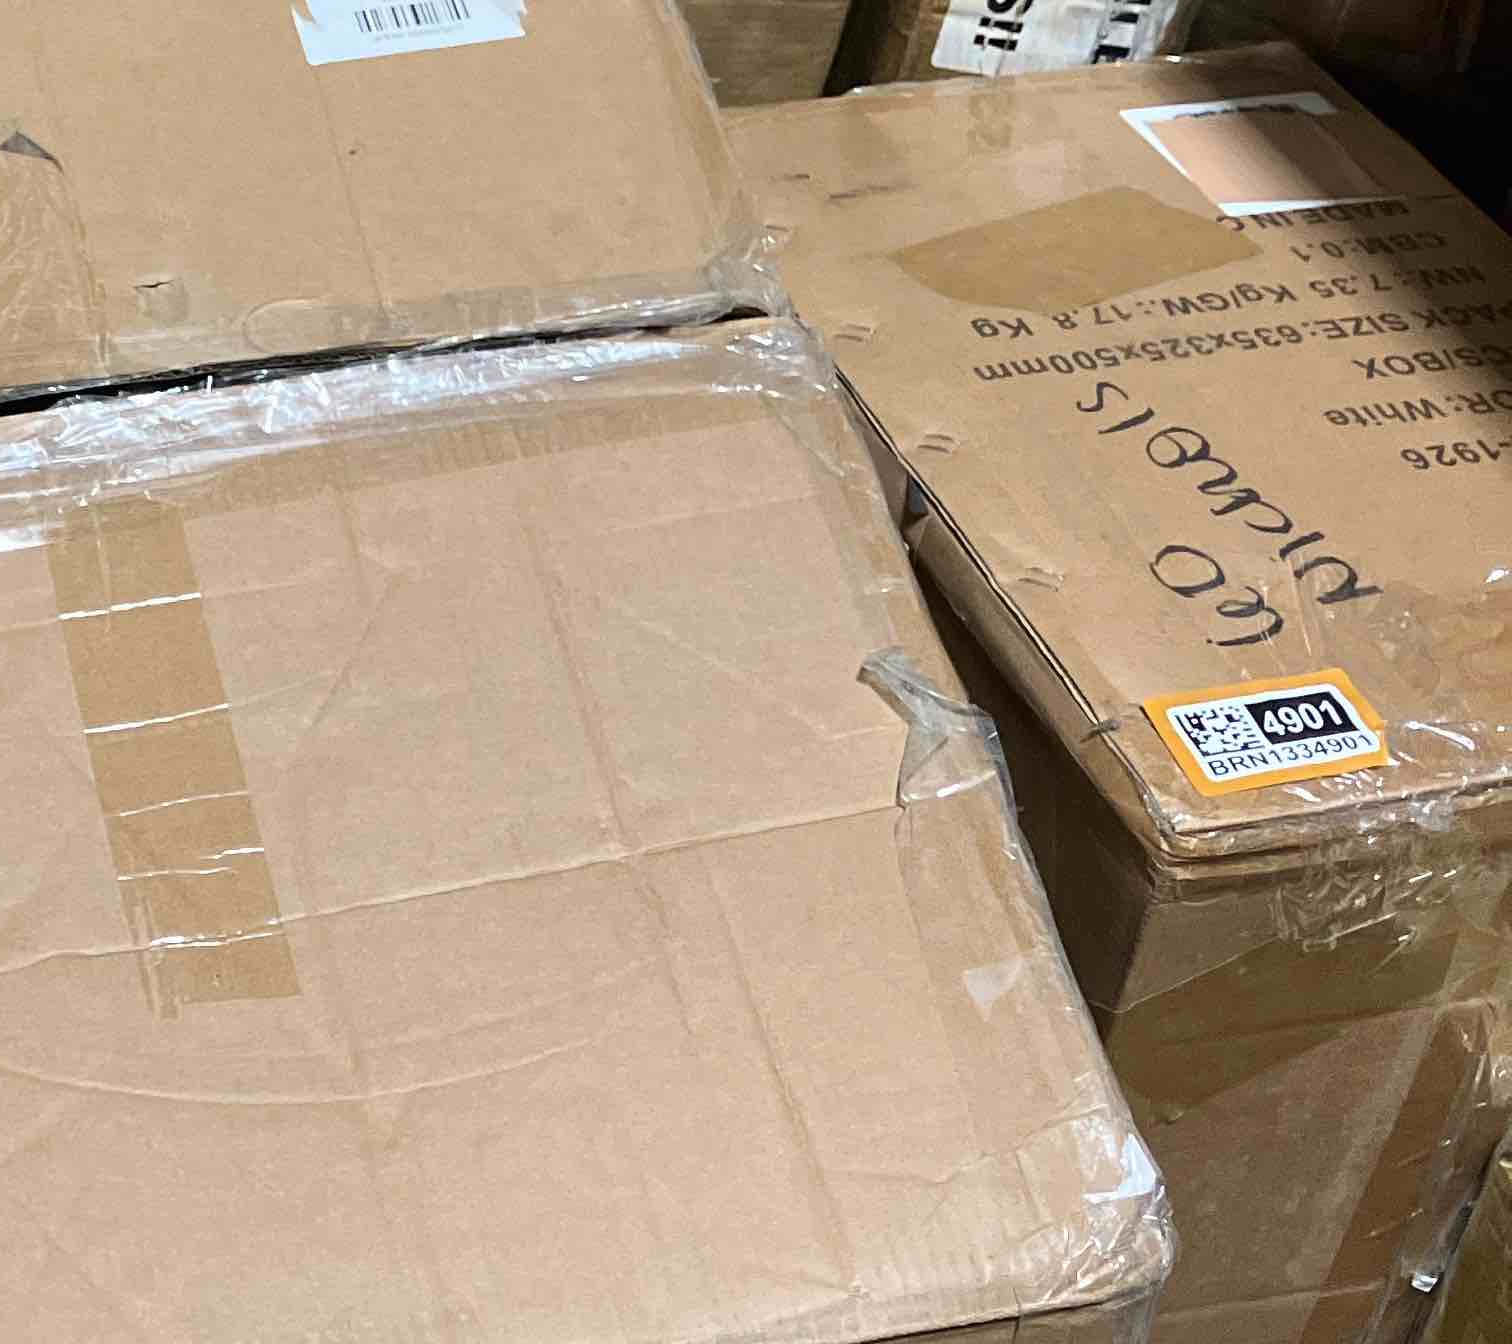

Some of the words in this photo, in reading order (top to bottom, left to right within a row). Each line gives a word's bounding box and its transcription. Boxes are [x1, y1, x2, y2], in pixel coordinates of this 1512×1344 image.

[970, 316, 1034, 340] Kg
[1262, 699, 1344, 736] 4901
[1207, 732, 1373, 777] BRN1334901
